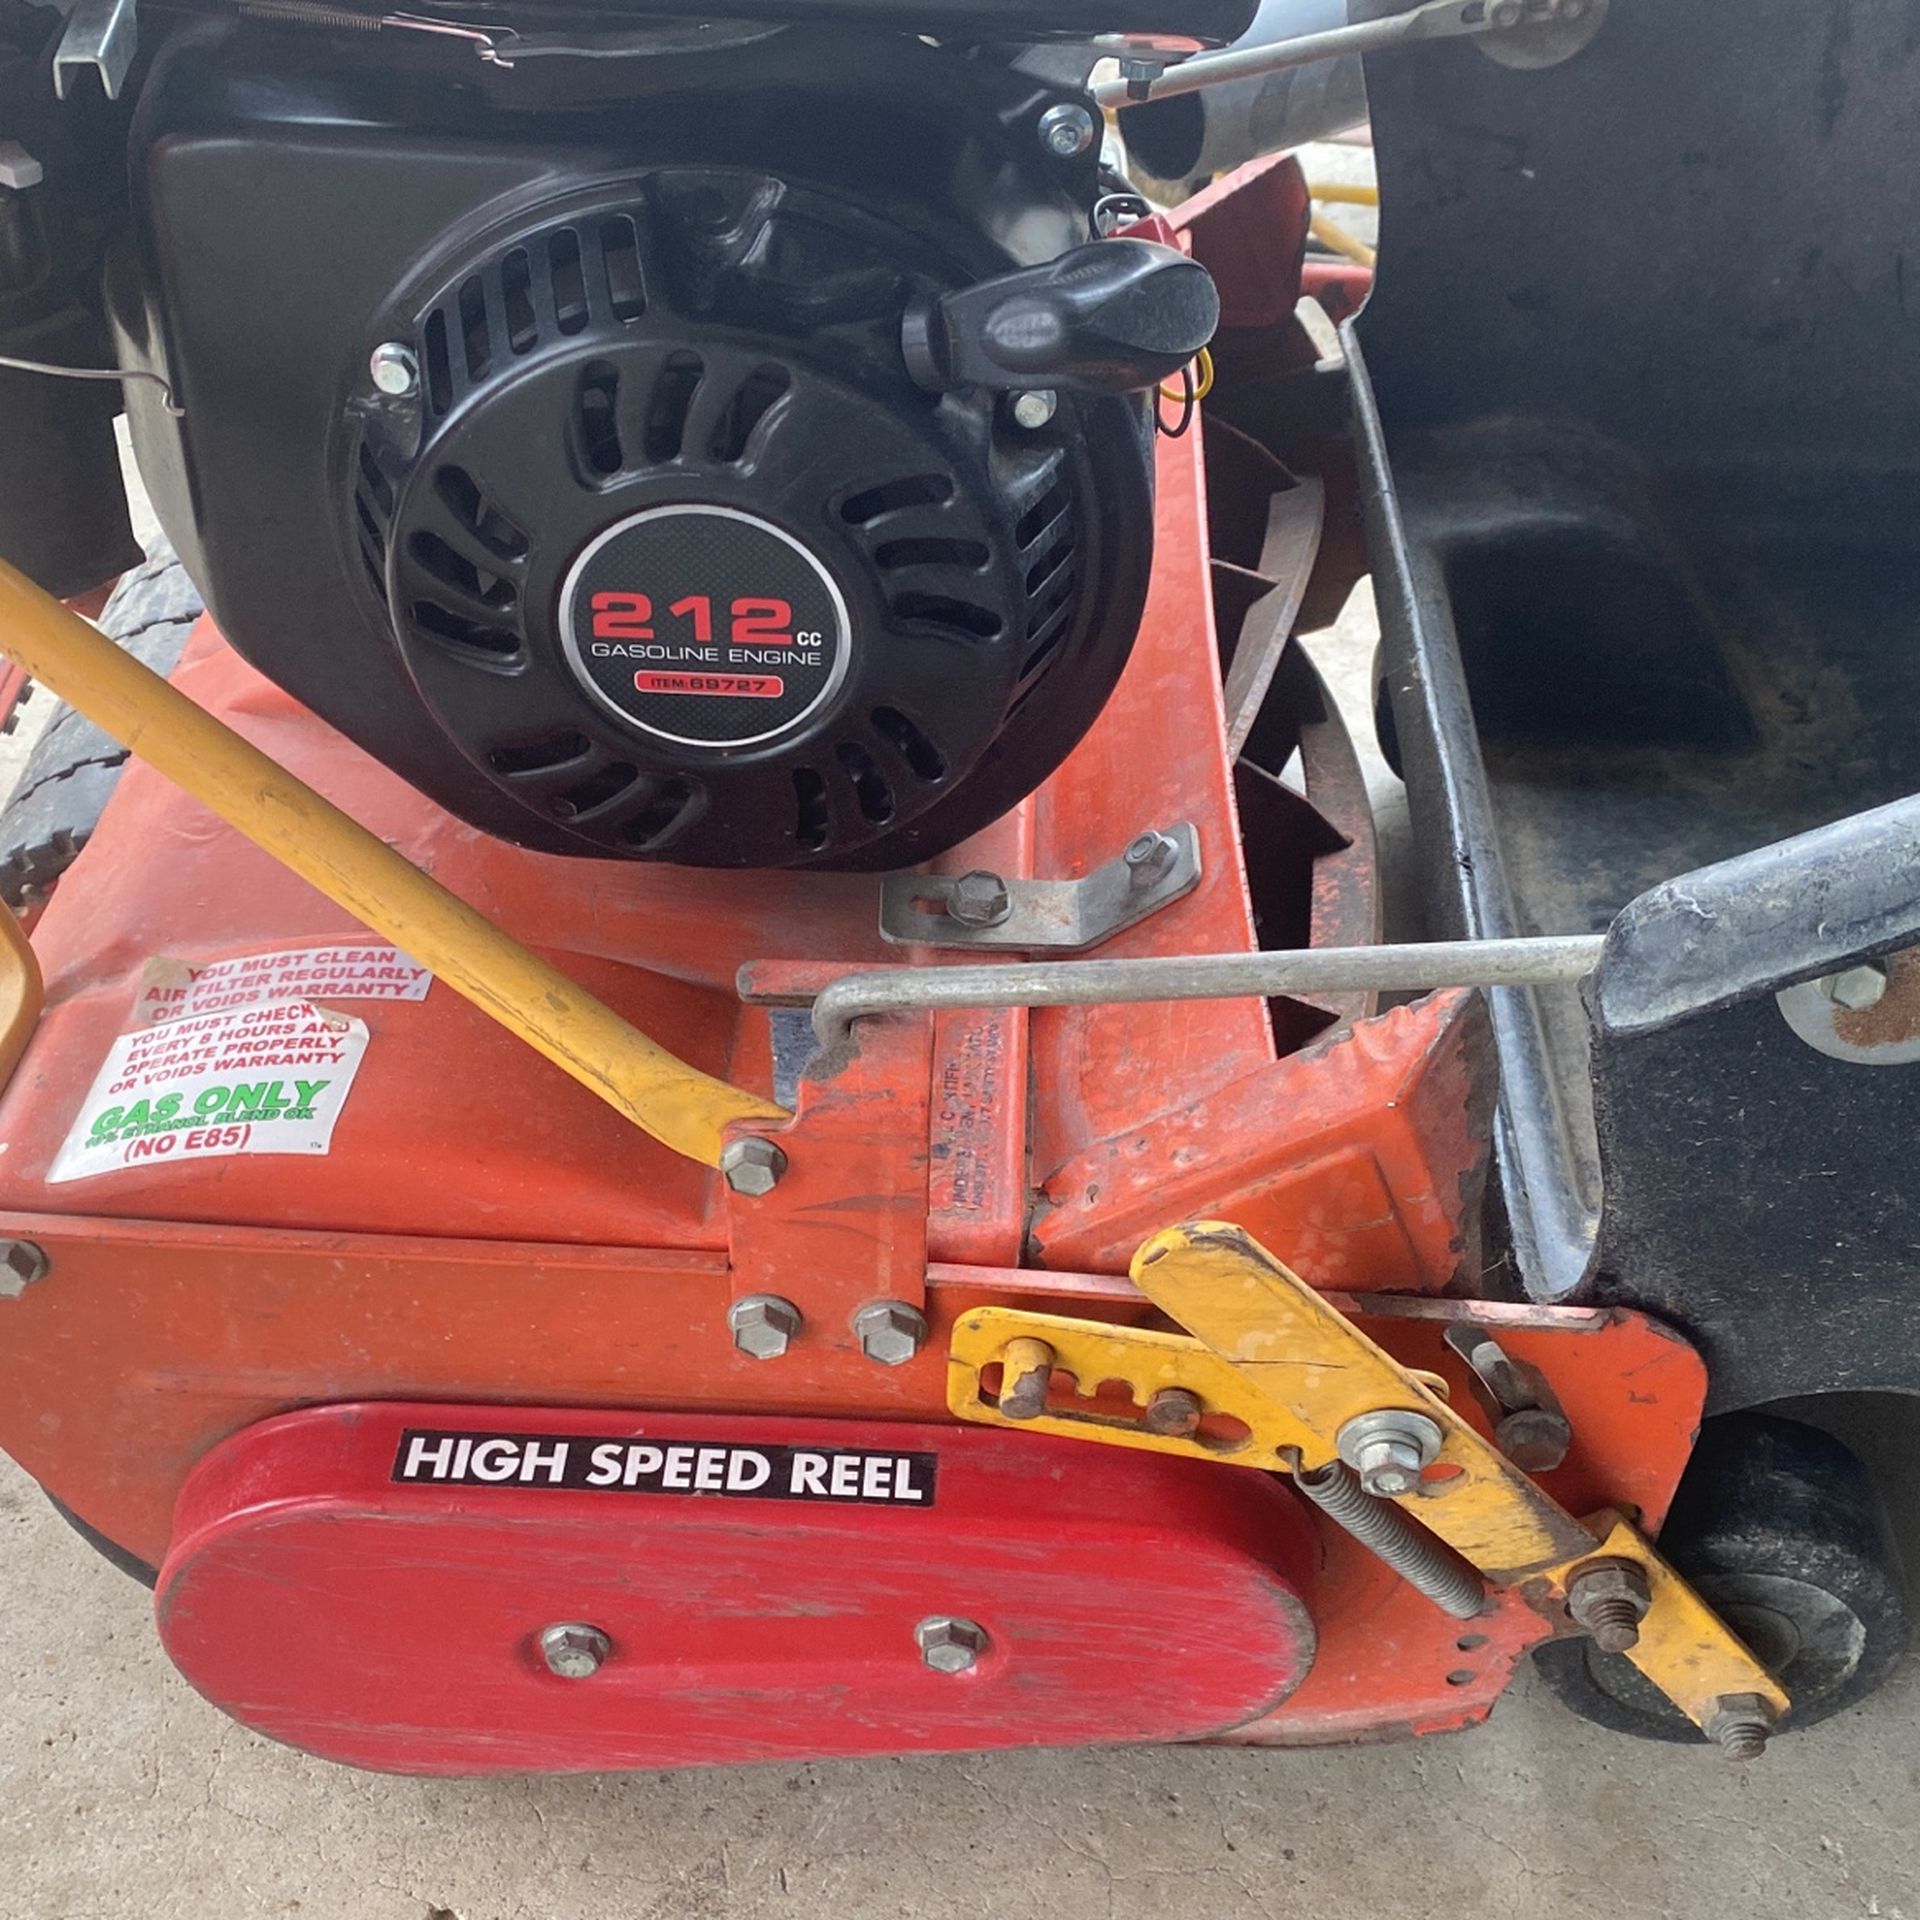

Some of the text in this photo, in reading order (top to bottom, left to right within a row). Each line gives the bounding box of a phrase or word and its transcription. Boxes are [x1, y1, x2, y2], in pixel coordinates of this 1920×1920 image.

[591, 590, 793, 646] 212
[591, 642, 822, 666] GASOLINE ENGINE
[143, 966, 428, 1002] AIR FILTER REGULARLY
[188, 951, 396, 982] YOU MUST CLEAN
[151, 1005, 184, 1022] OR
[193, 989, 262, 1013] VOIDS
[267, 982, 410, 1000] WARRANTY
[126, 1036, 193, 1063] EVERY
[199, 1032, 213, 1045] 8
[217, 1023, 297, 1042] HOURS
[130, 1003, 318, 1048] YOU MUST CHECK
[108, 1051, 346, 1095] OR VOIDS WARRANTY
[121, 1036, 345, 1077] OPERATE PROPERLY
[90, 1079, 333, 1136] GAS ONLY
[120, 1114, 210, 1141] ETHANOL
[211, 1107, 281, 1125] BLEND
[282, 1107, 317, 1121] OK
[123, 1123, 252, 1163] (NO E85)
[402, 1436, 924, 1501] HIGH SPEED REEL
